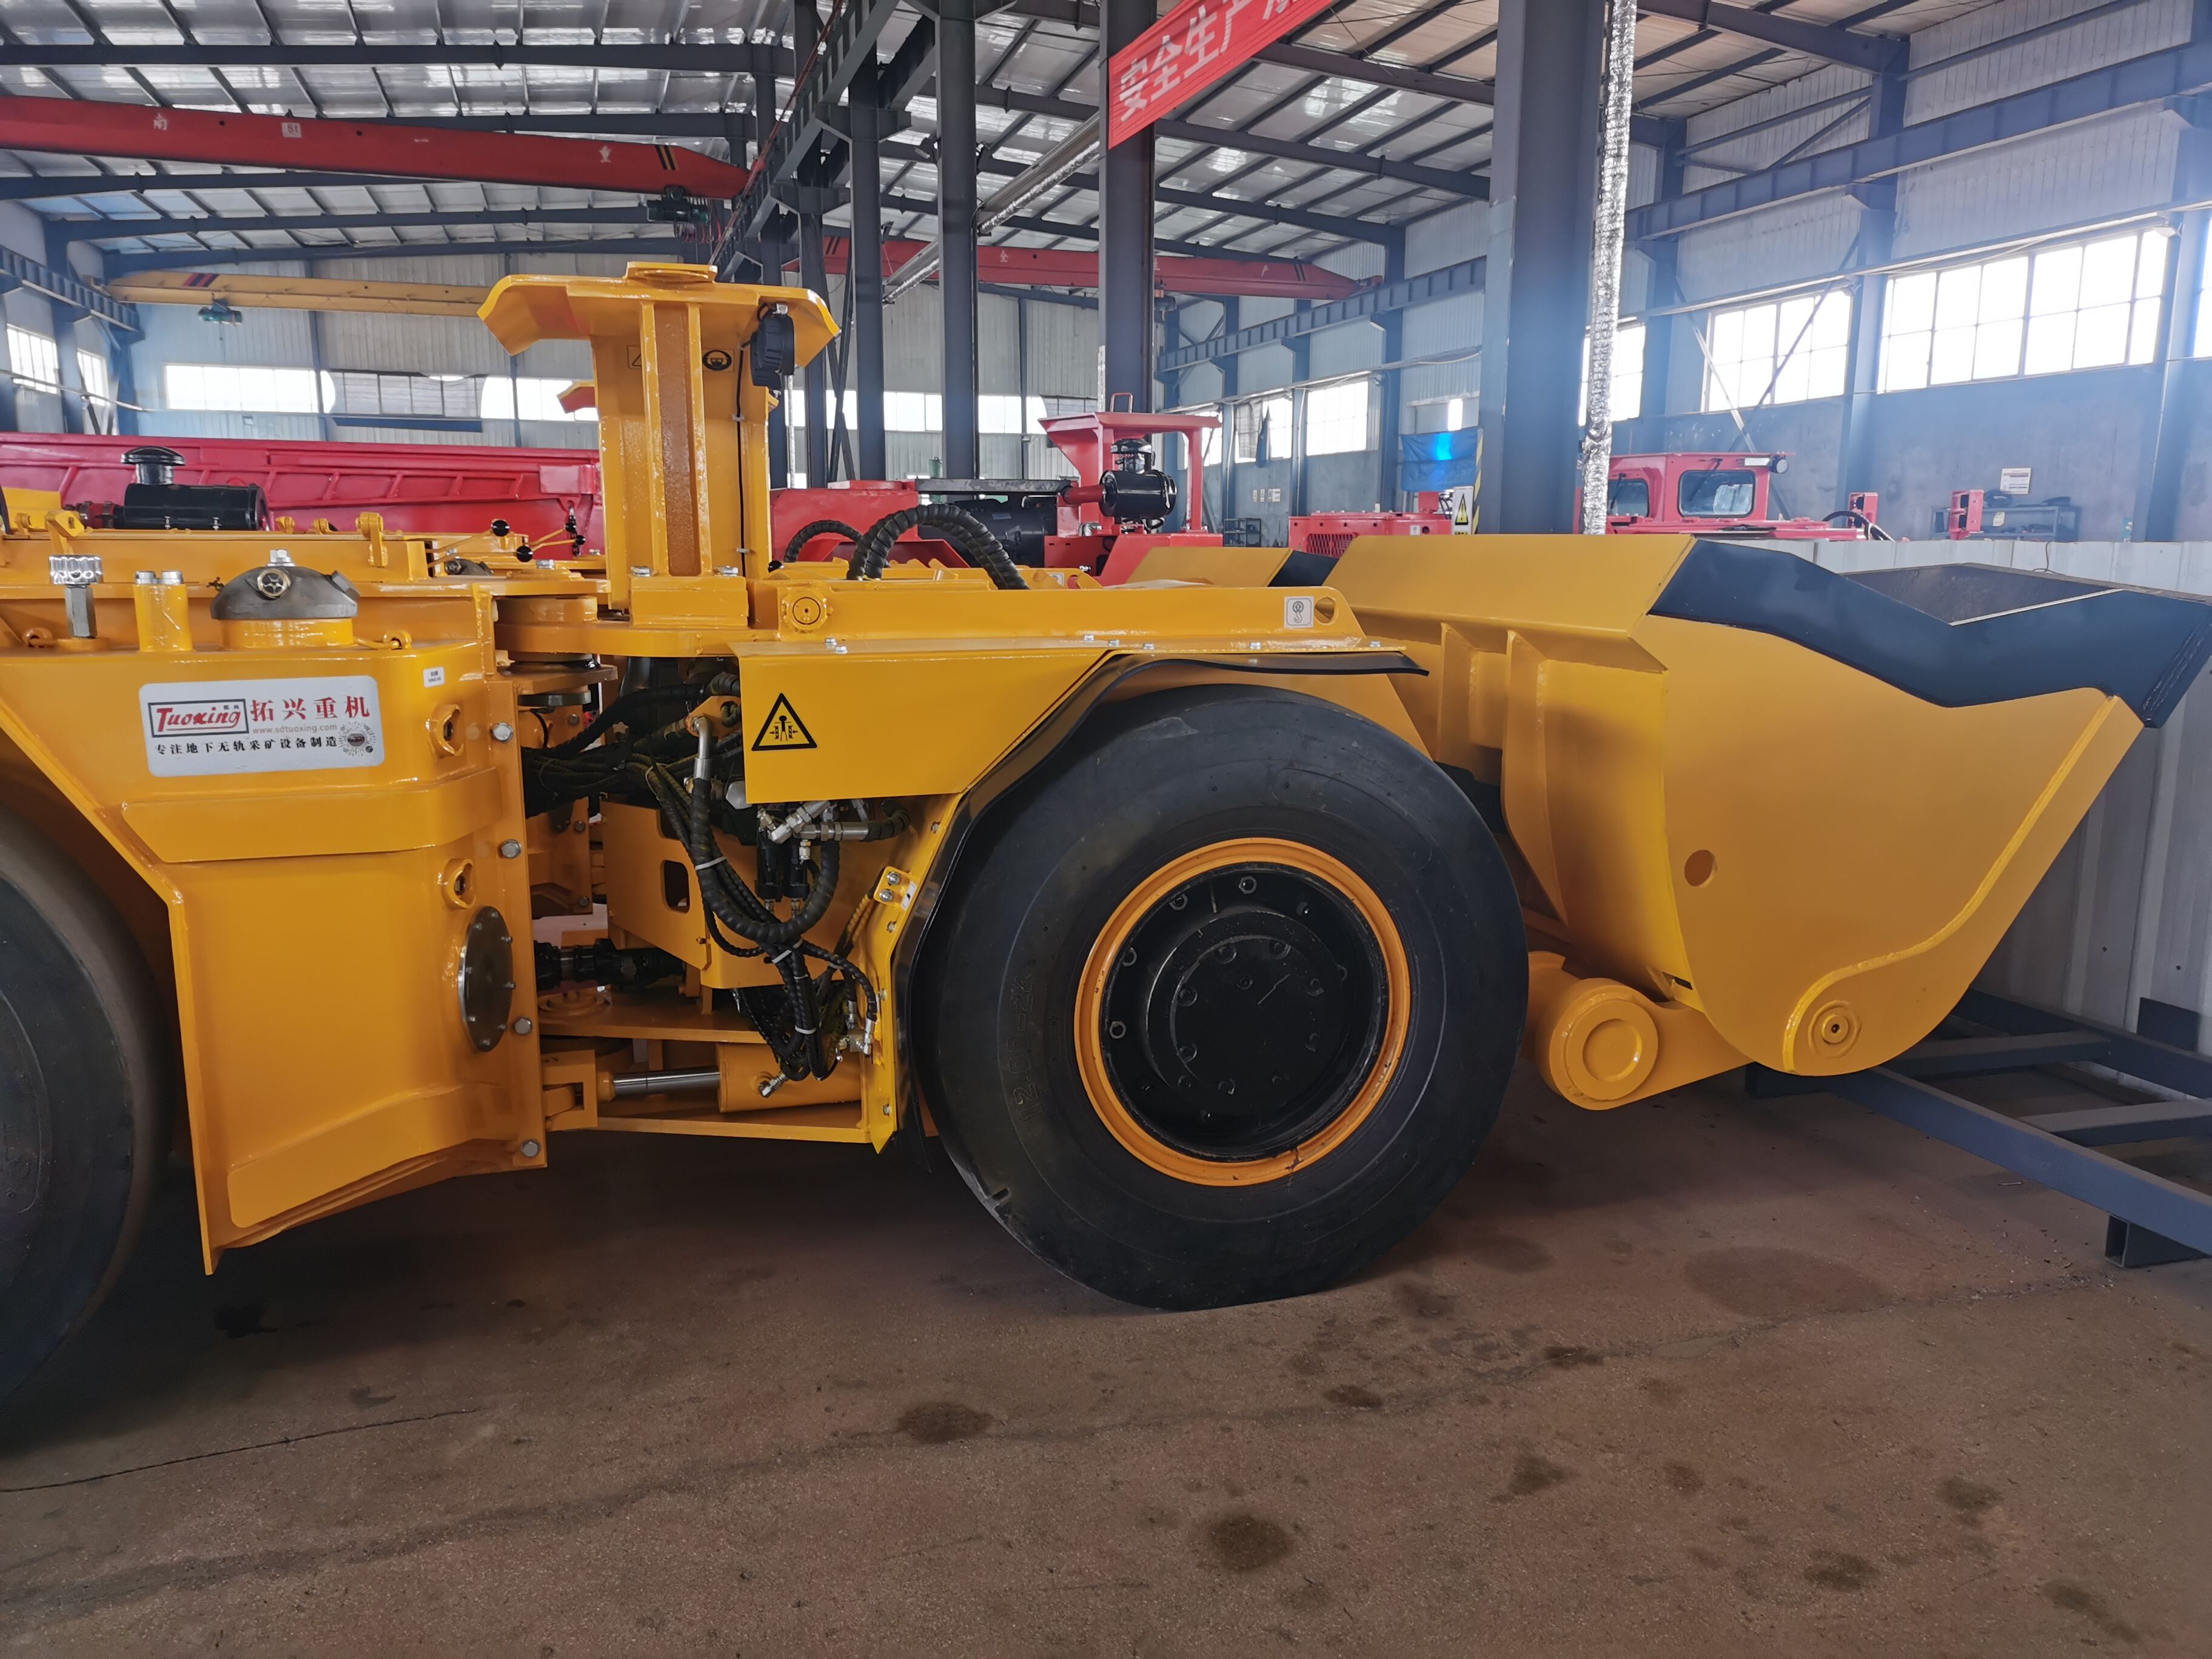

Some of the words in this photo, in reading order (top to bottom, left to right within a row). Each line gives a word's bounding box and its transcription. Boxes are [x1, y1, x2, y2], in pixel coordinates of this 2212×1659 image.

[1119, 0, 1298, 122] 安全生产
[156, 706, 241, 732] Tuoxing
[250, 695, 370, 722] 拓兴重机
[252, 723, 338, 734] www.sdtuoxing.com
[155, 736, 338, 755] 专注地下无轨采矿设备制造
[1005, 974, 1043, 1121] 12.00-24
